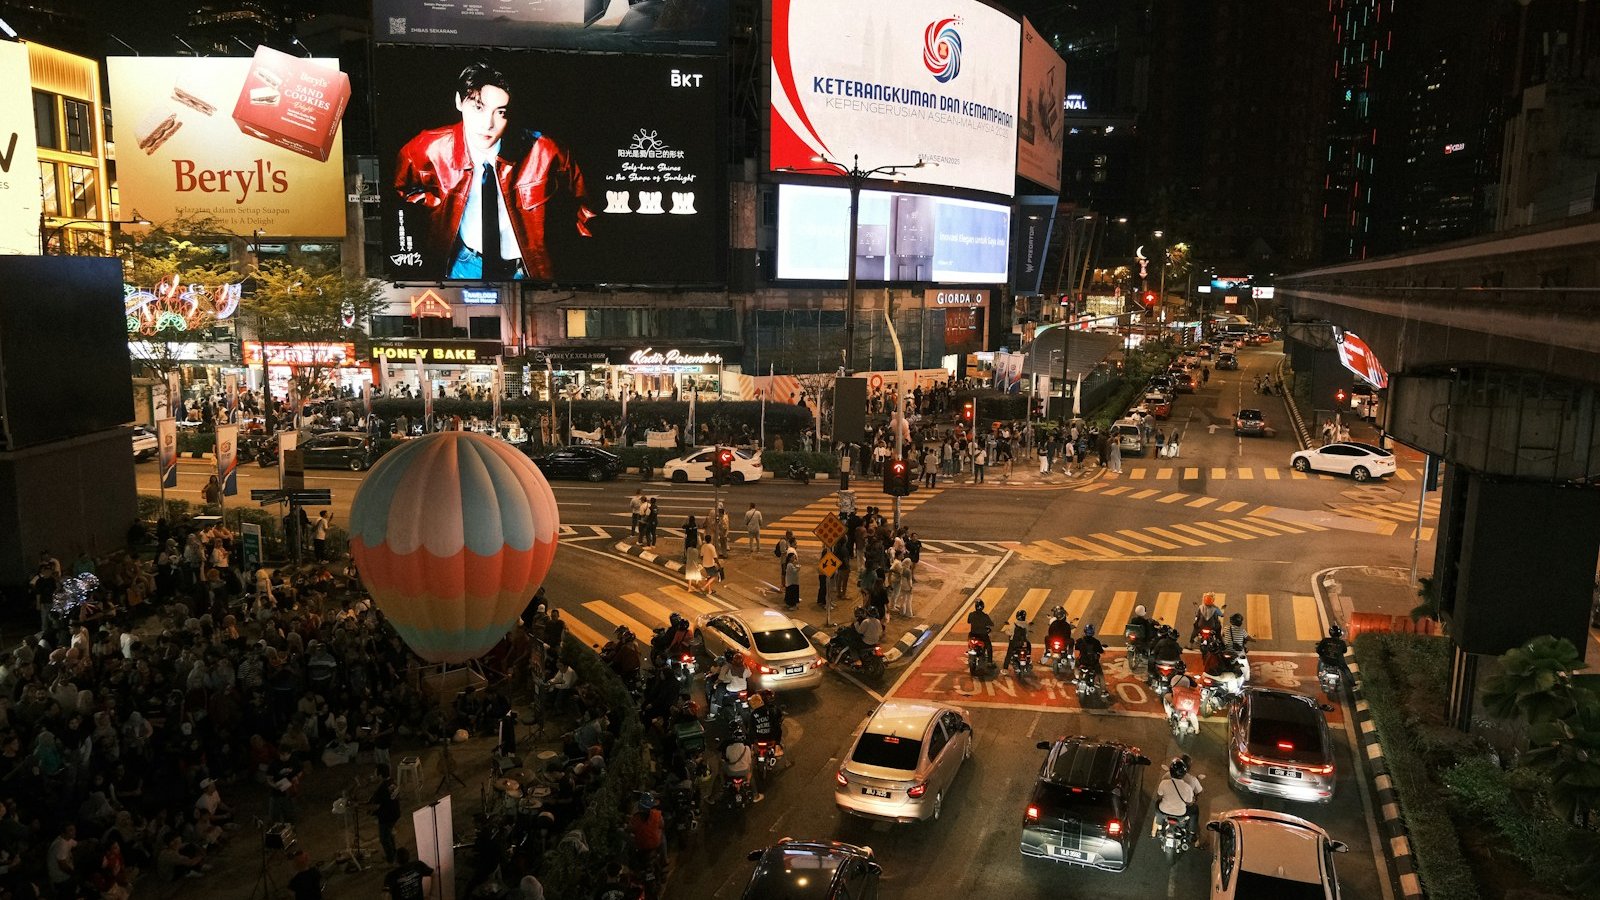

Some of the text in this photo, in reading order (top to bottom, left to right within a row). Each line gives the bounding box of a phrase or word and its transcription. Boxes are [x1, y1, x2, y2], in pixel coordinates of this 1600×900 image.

[295, 84, 324, 99] SAND
[284, 89, 331, 110] COOKIES
[813, 76, 1014, 128] KETERANGKUMAN DAN KEMAMPANAN
[825, 97, 926, 120] KEPENGERUSIAN
[657, 162, 682, 172] Shines
[172, 158, 289, 205] Beryl's
[615, 173, 626, 181] the
[628, 172, 652, 183] Shape
[652, 175, 661, 183] of
[663, 172, 697, 184] Sunlight
[213, 206, 236, 214] dalam
[238, 206, 261, 216] Setiap
[262, 206, 290, 216] Suapan
[247, 217, 274, 226] Delight
[937, 292, 982, 305] GIORDAO
[372, 347, 476, 360] HONEY BAKE
[629, 347, 721, 365] Kadir Pasembor
